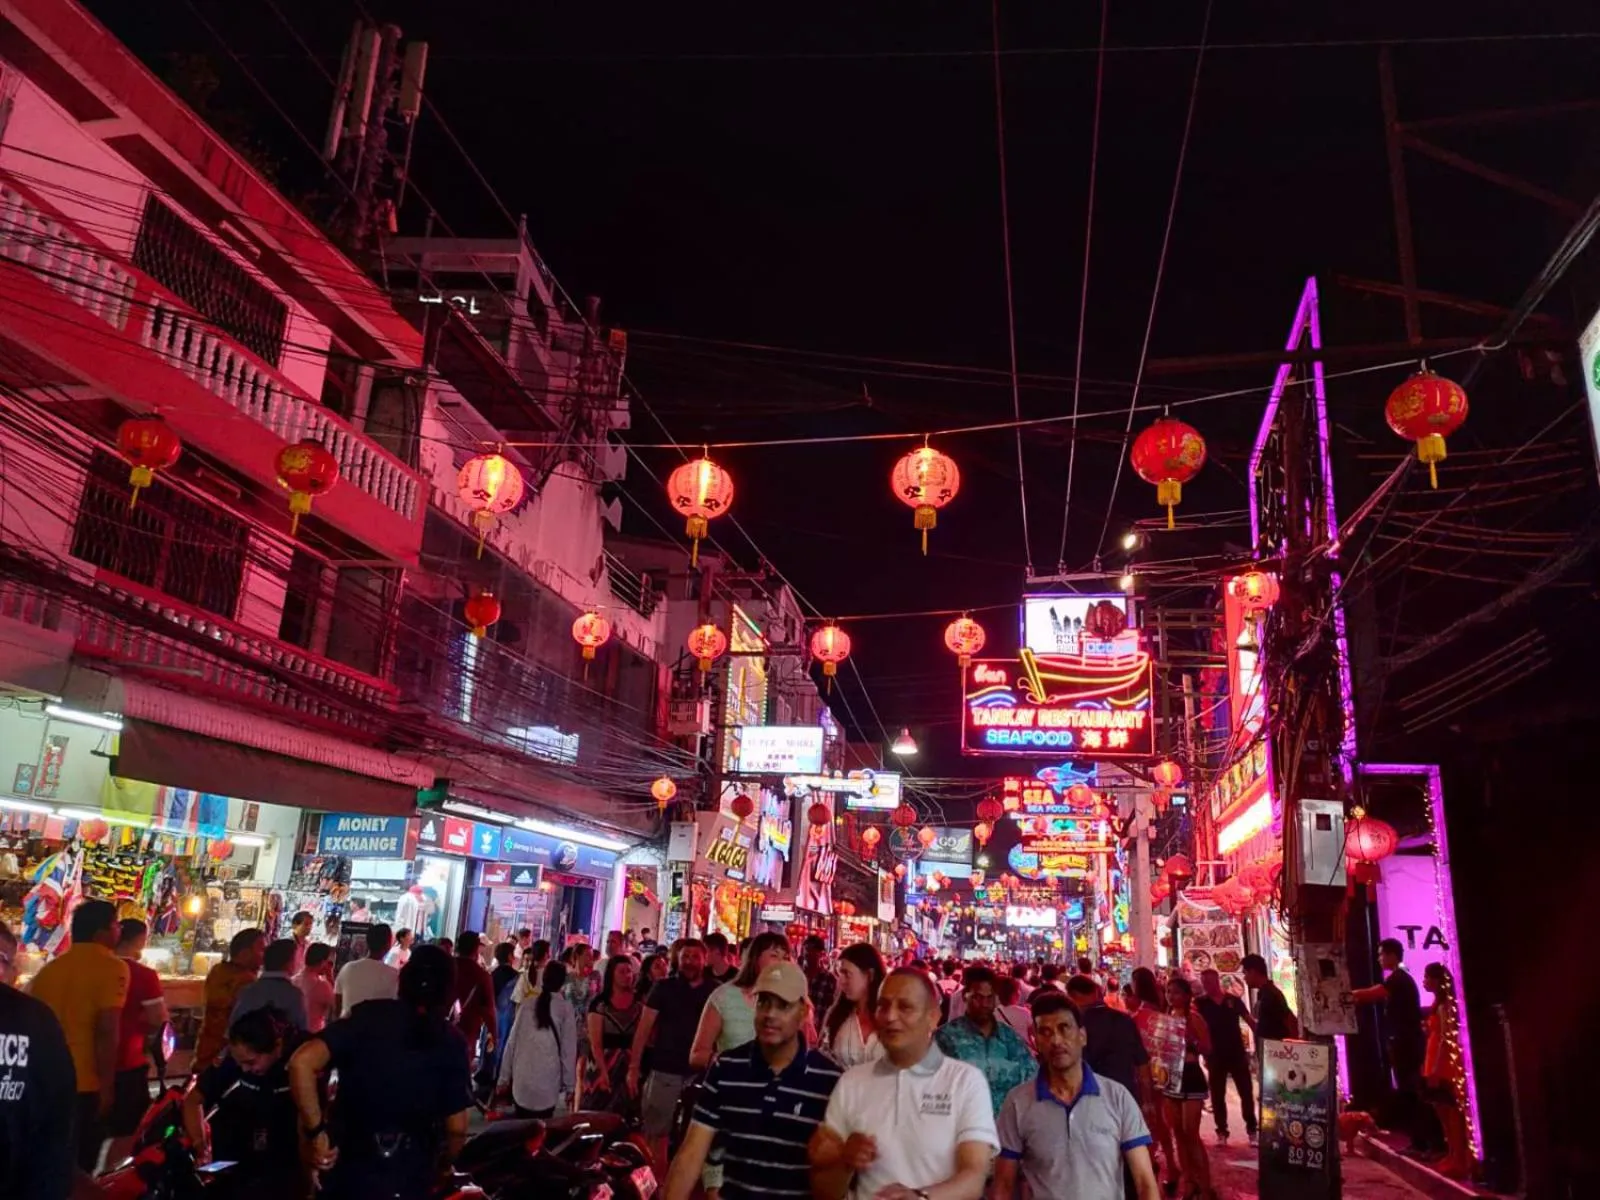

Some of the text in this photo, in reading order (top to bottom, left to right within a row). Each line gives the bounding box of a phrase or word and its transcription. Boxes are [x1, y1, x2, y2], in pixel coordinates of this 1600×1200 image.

[1038, 709, 1145, 728] RESTAURANT
[986, 729, 1072, 745] SEAFOOD
[337, 817, 389, 832] MONEY
[325, 836, 397, 852] EXCHANGE
[1396, 925, 1450, 951] TA
